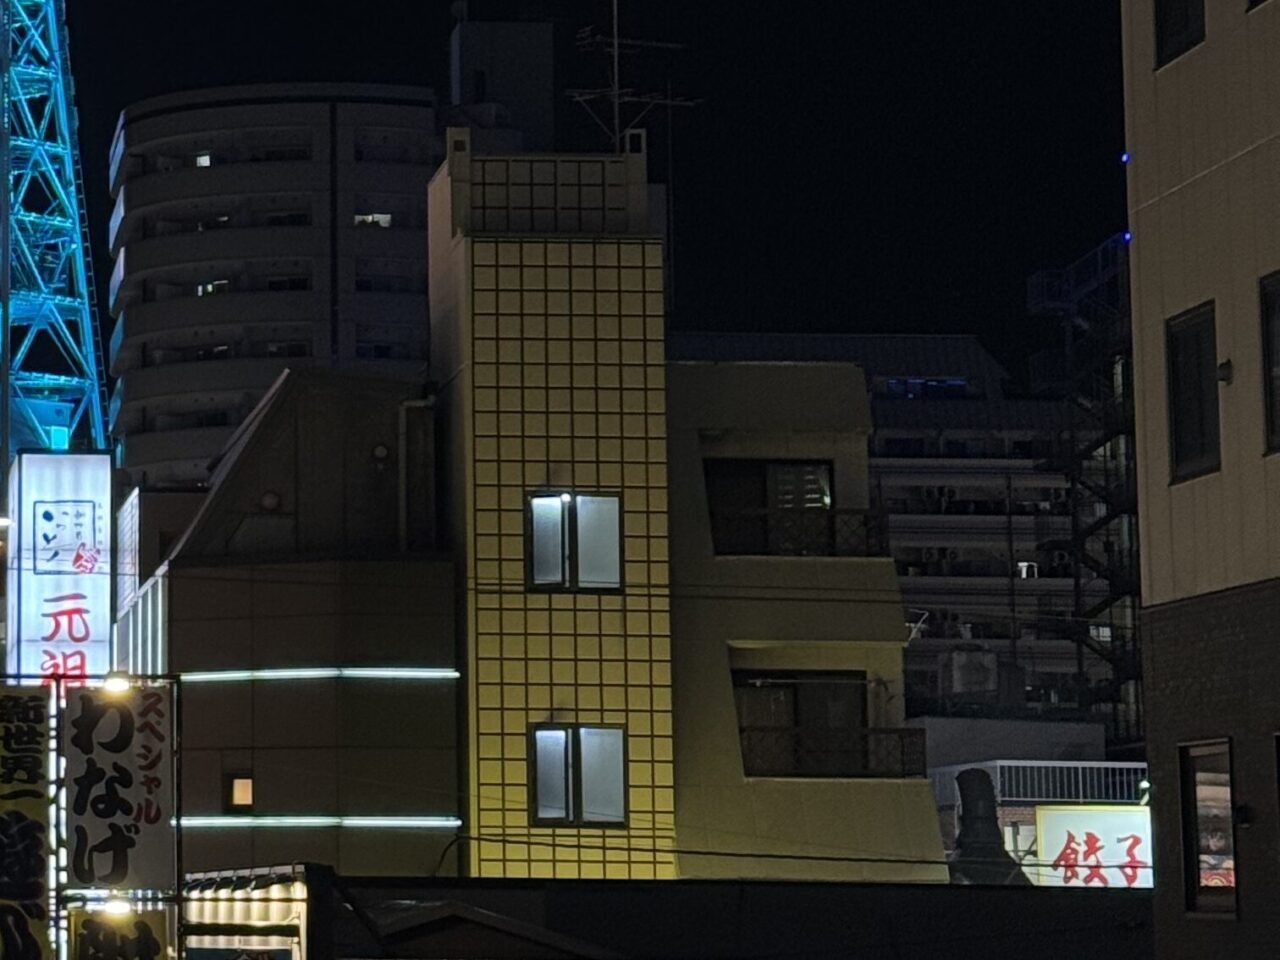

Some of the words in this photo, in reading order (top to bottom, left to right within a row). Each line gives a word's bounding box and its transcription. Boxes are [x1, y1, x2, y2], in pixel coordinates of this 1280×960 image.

[71, 693, 141, 885] わなげ
[136, 692, 166, 825] スペシャル
[1052, 830, 1148, 887] 餃子
